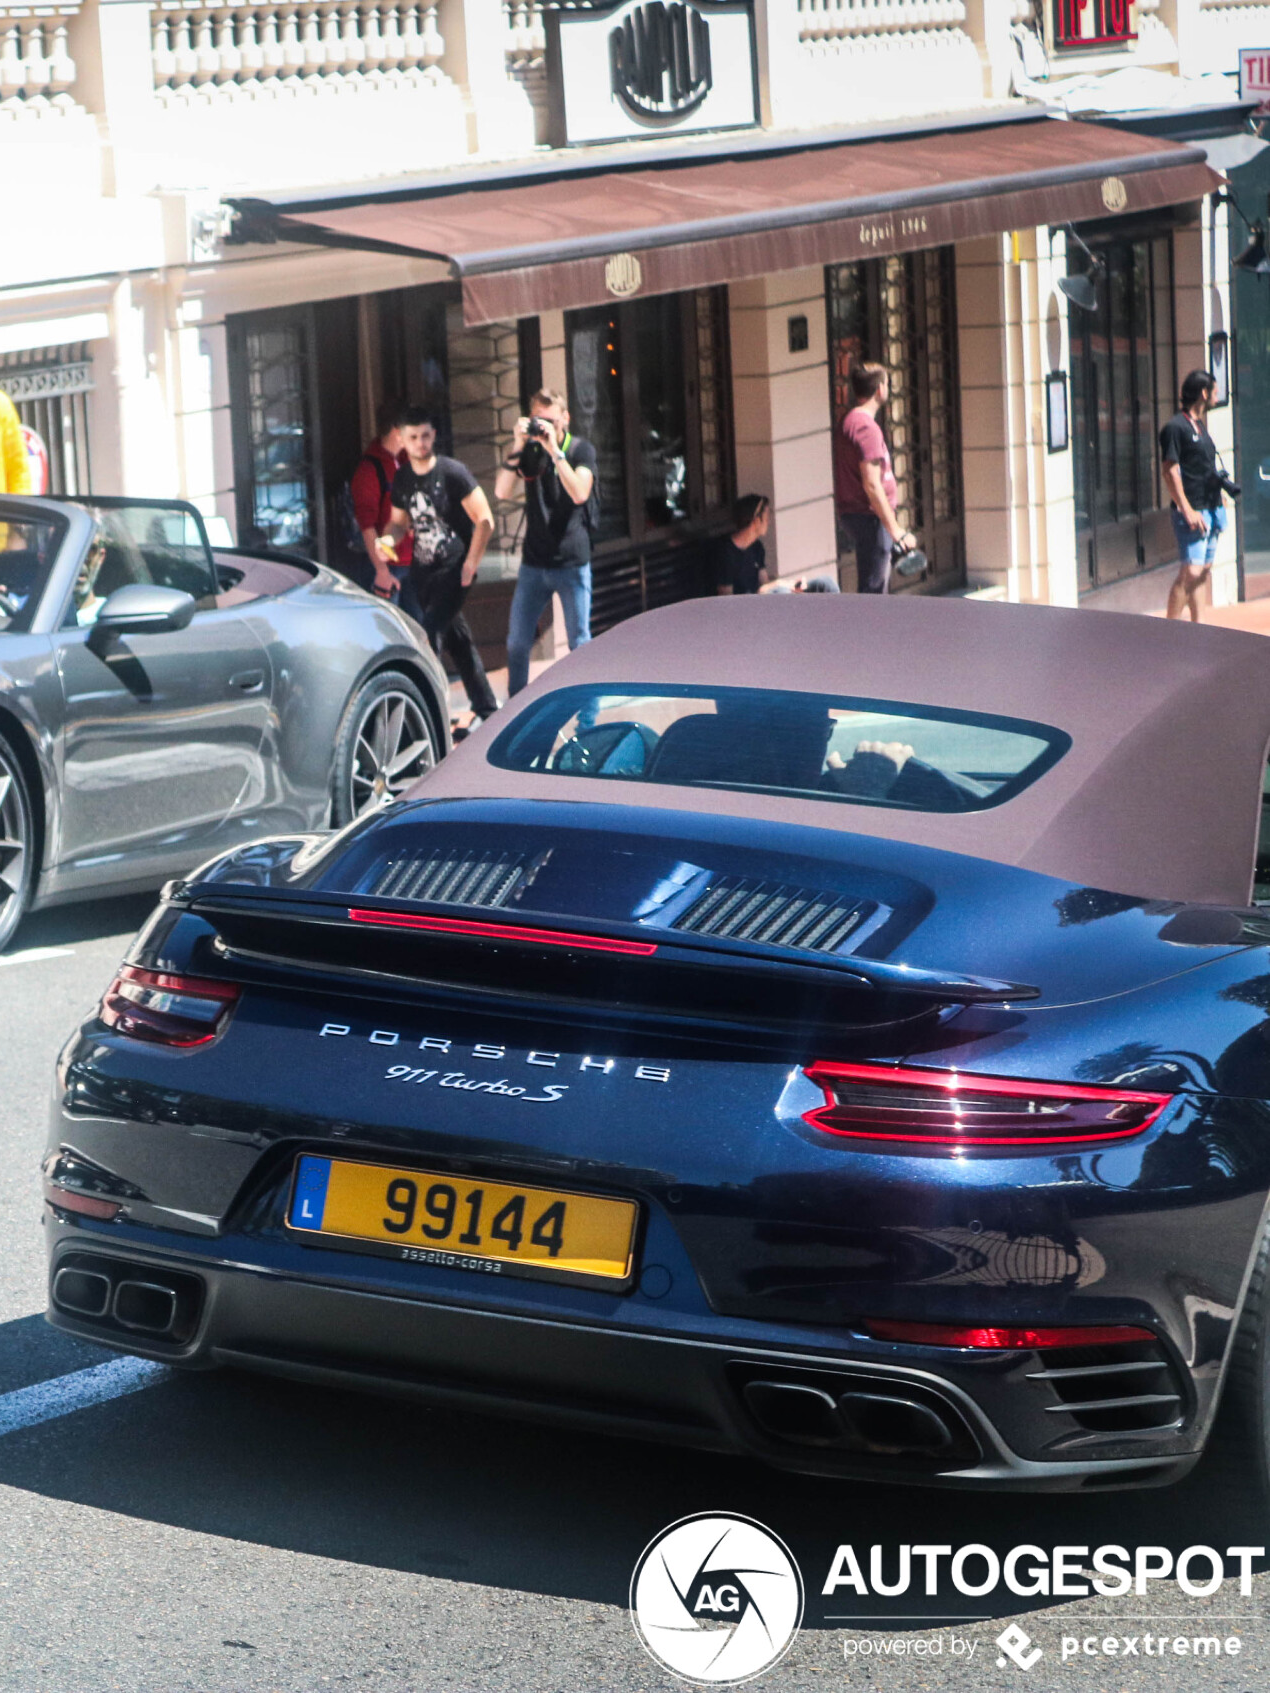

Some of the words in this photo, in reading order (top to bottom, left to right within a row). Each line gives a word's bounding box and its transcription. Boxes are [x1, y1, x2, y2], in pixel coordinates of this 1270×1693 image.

[319, 1023, 672, 1083] PORSCHE
[384, 1065, 438, 1084] 911
[439, 1072, 526, 1096] turbo
[521, 1085, 569, 1102] S
[300, 1199, 314, 1219] L
[382, 1178, 567, 1258] 99144
[401, 1248, 502, 1273] assetto-corsa
